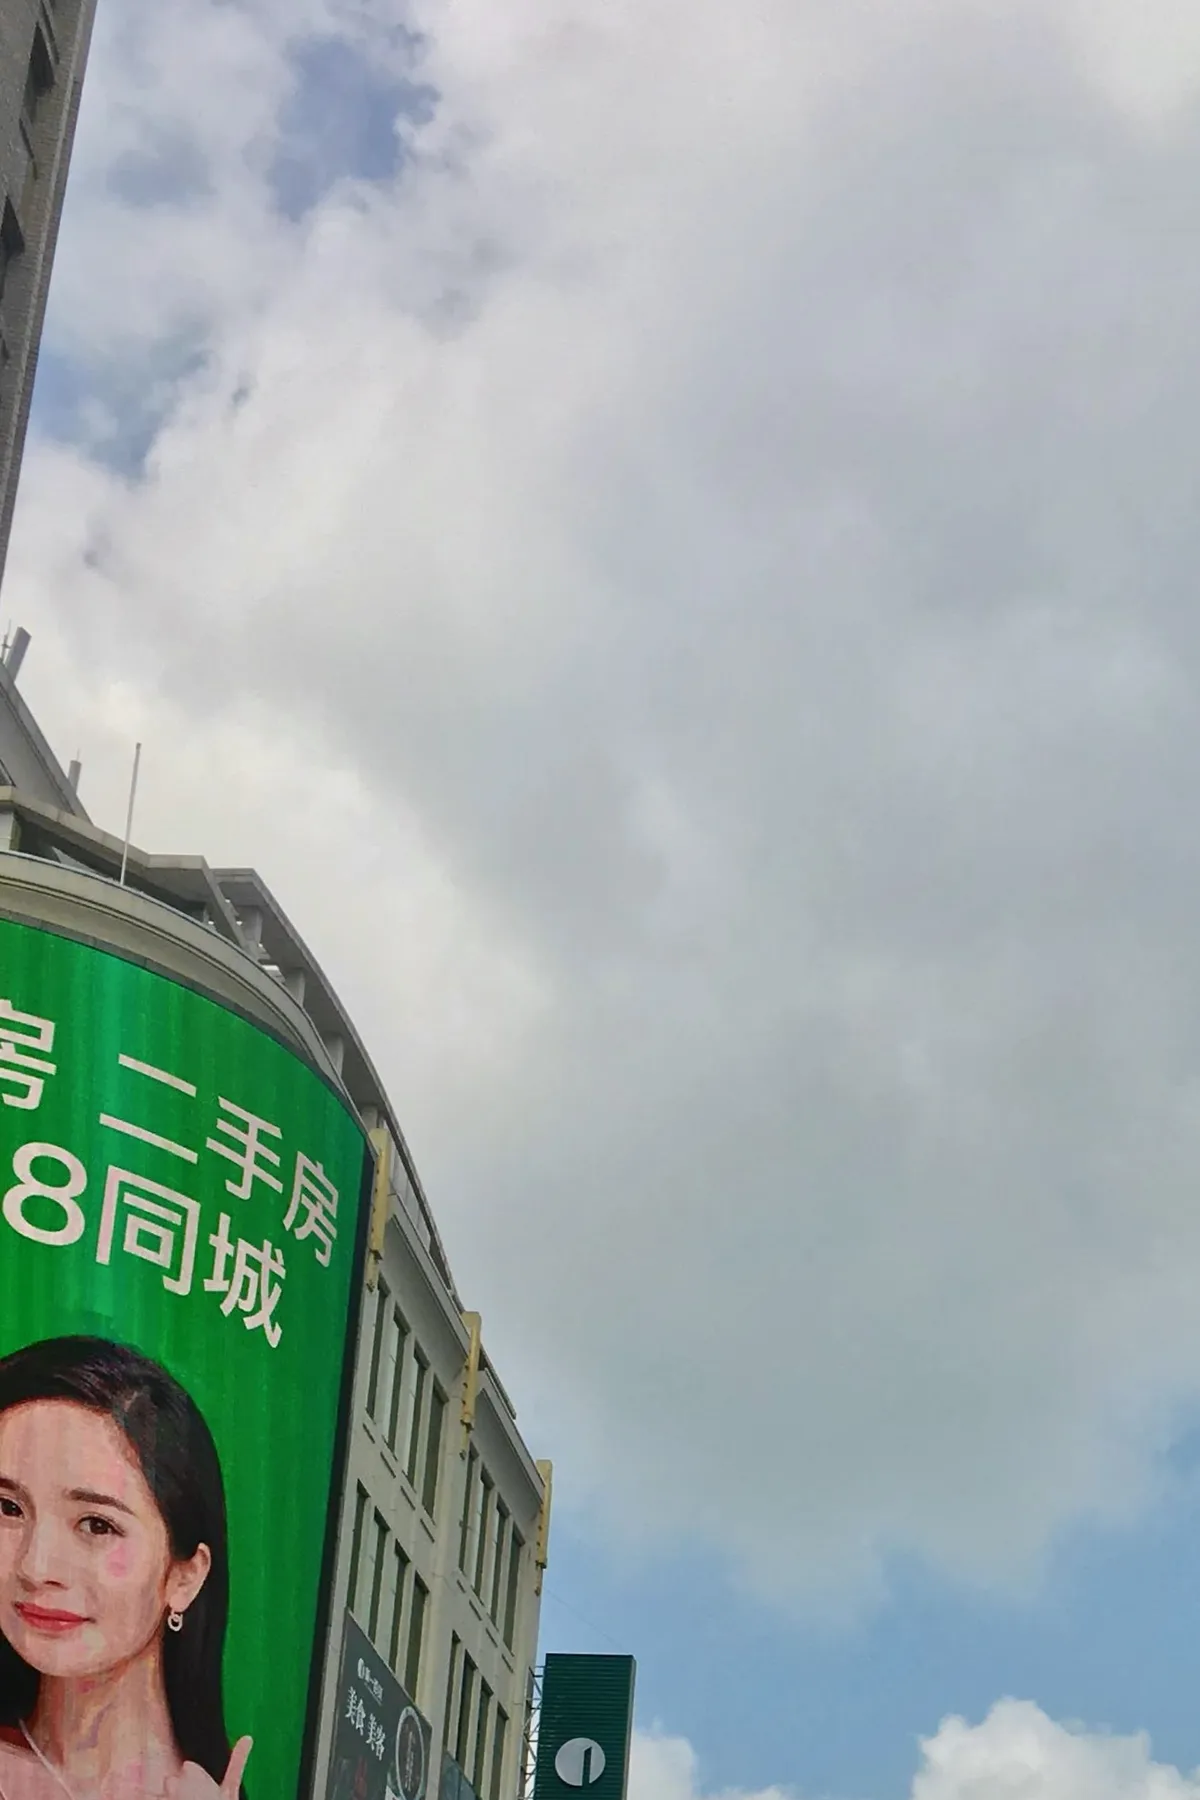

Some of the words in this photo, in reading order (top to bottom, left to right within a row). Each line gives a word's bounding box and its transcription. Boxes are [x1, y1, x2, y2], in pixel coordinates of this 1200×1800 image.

[2, 1141, 287, 1349] 8同城
[99, 1054, 340, 1267] 二手房
